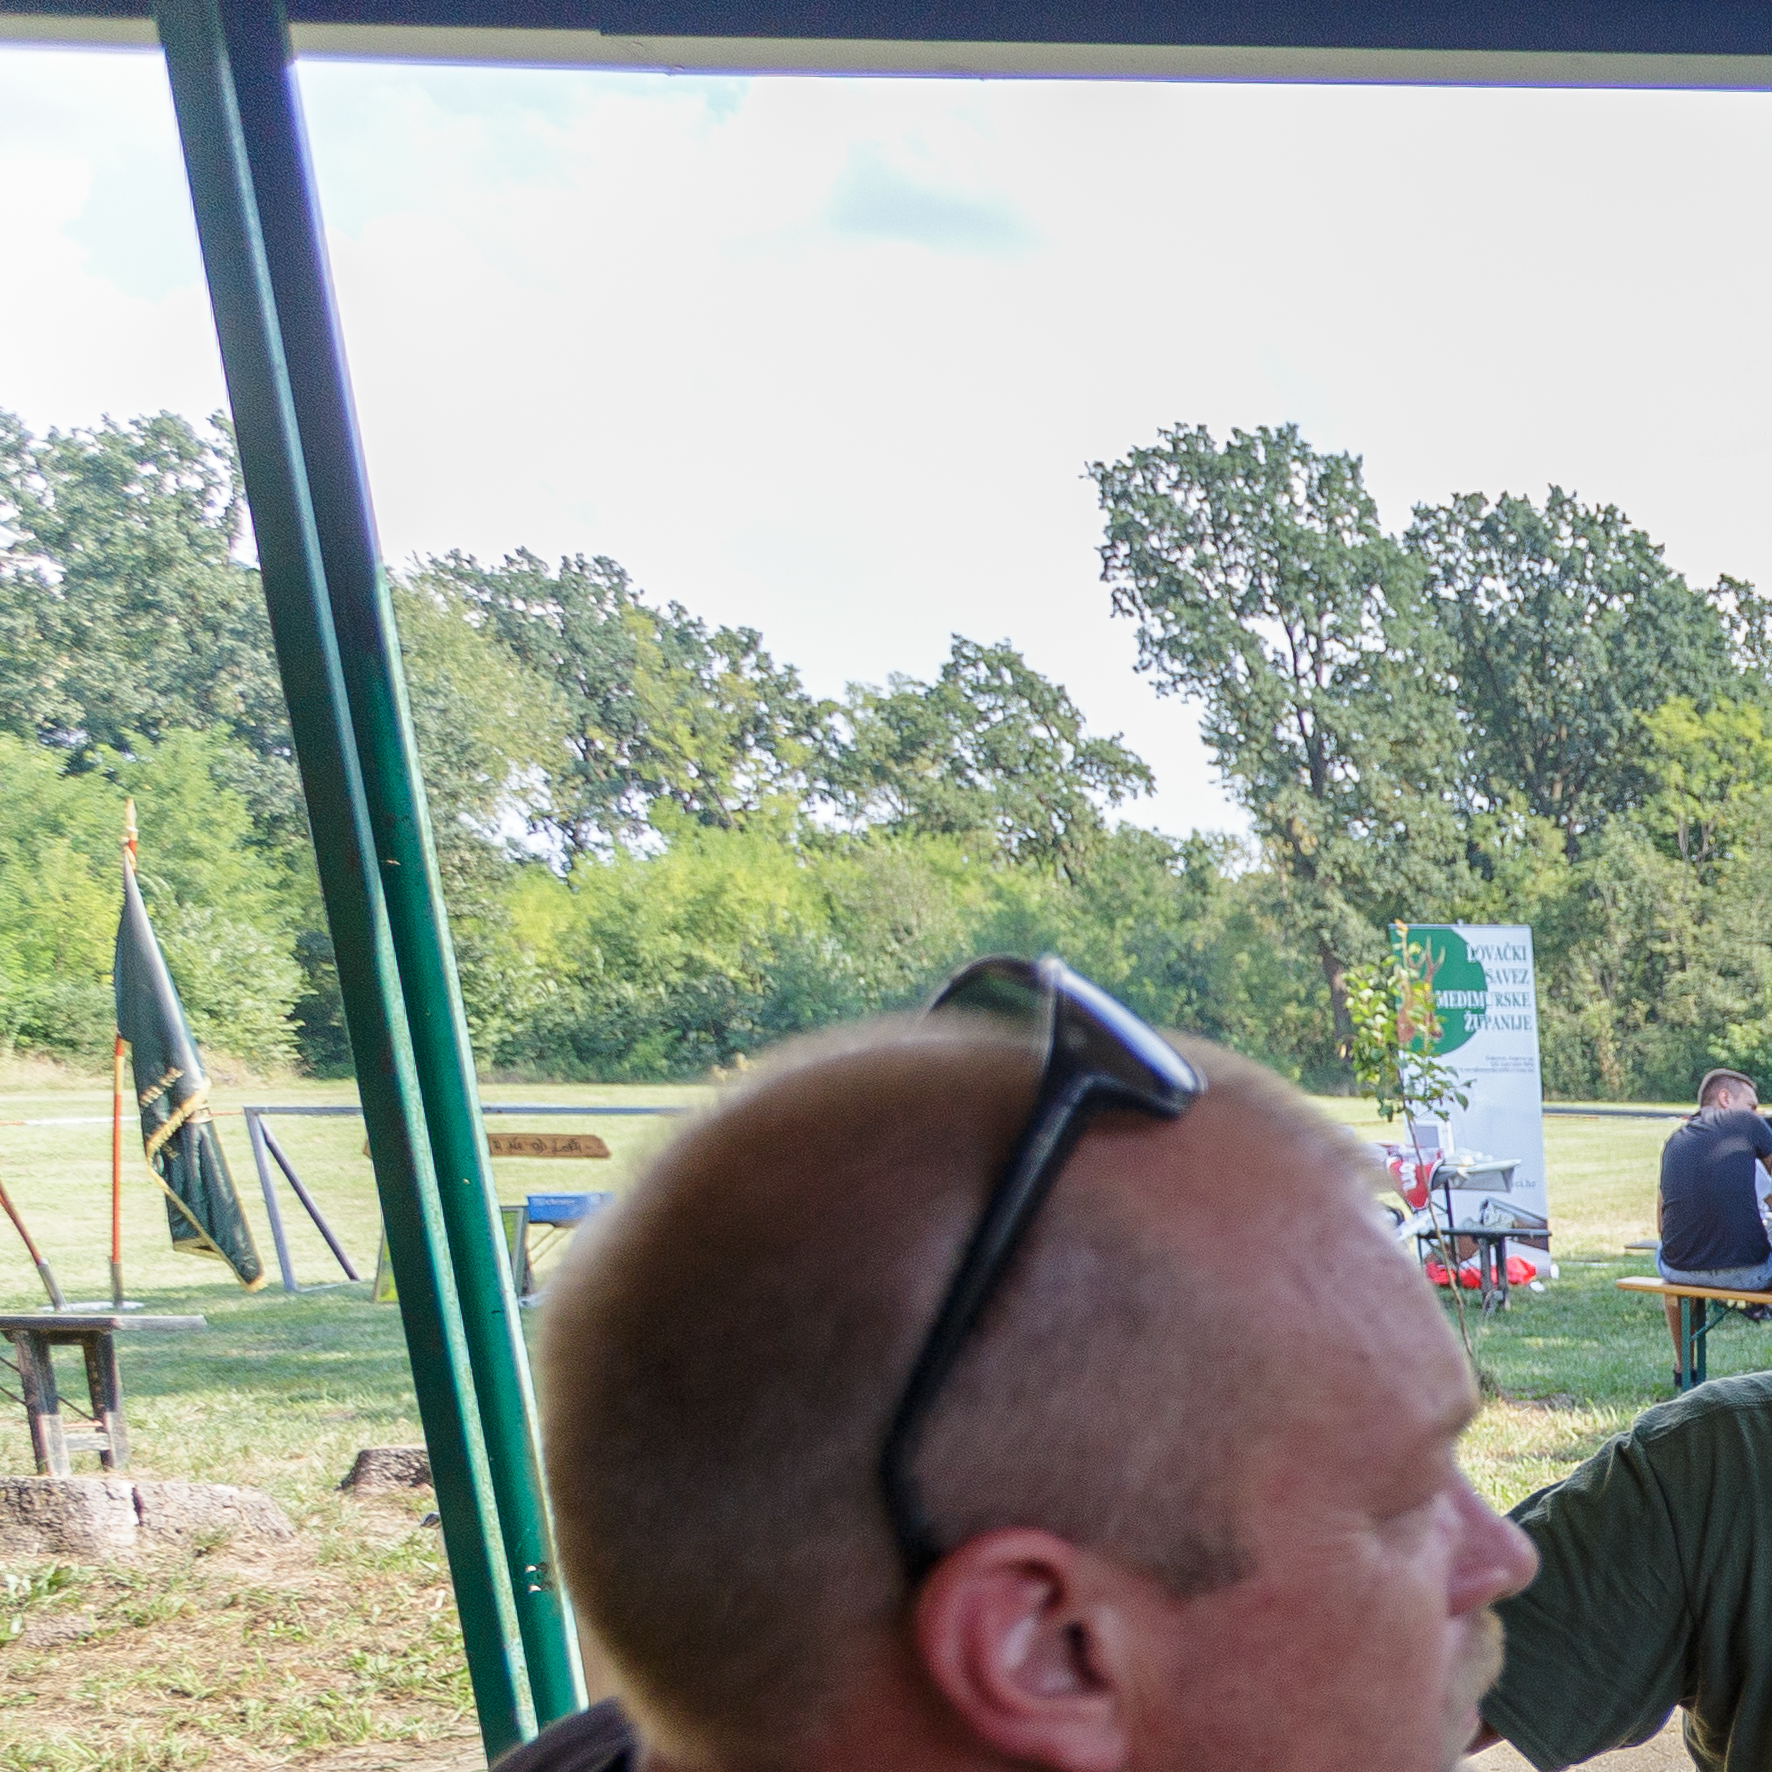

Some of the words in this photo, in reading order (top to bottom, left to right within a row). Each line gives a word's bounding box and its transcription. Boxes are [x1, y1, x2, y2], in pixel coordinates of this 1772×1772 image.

[1466, 942, 1528, 963] LOVAČKI
[1485, 967, 1530, 985] SAVEZ
[1464, 1010, 1532, 1033] ŽUPANIJE
